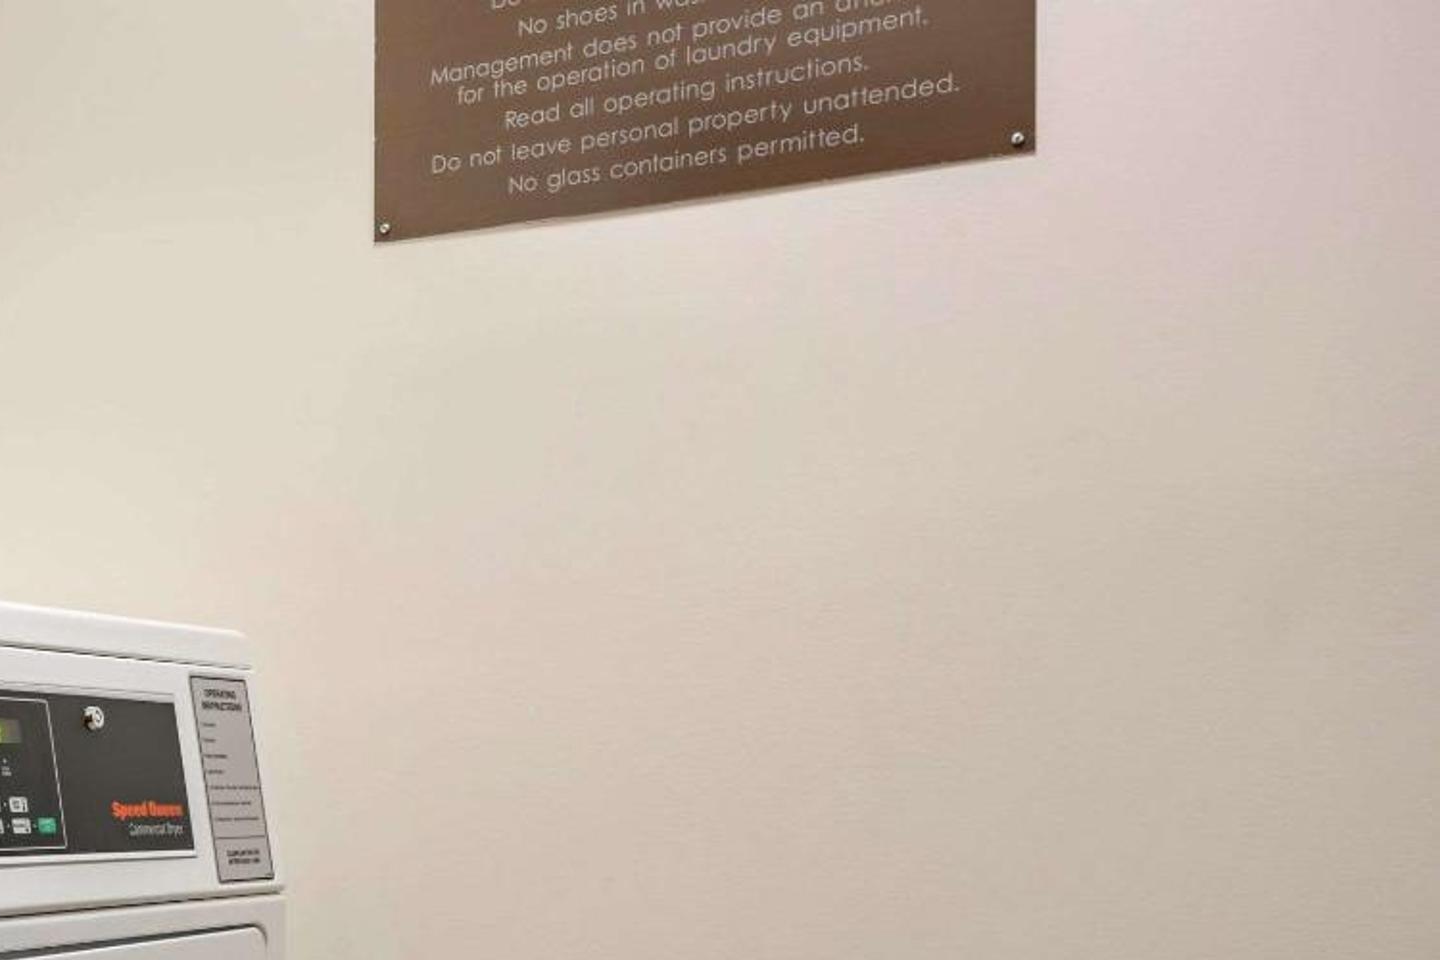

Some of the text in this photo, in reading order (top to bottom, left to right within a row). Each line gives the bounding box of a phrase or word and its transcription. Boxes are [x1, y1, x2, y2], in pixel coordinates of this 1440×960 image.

[431, 42, 573, 85] Management
[584, 35, 637, 59] does
[648, 24, 682, 46] not
[691, 6, 782, 42] provide
[793, 0, 824, 20] an
[457, 85, 485, 105] for
[494, 78, 527, 99] the
[536, 58, 645, 93] operation
[655, 50, 676, 71] of
[686, 34, 776, 66] laundry
[787, 6, 929, 48] equipment.
[518, 17, 548, 38] No
[556, 3, 617, 31] shoes
[626, 0, 645, 16] in
[432, 72, 960, 175] Do not leave personal property unattended.
[505, 55, 870, 131] Read all operating instructions.
[509, 123, 865, 194] No glass containers permitted.
[111, 800, 185, 821] Speed Queen
